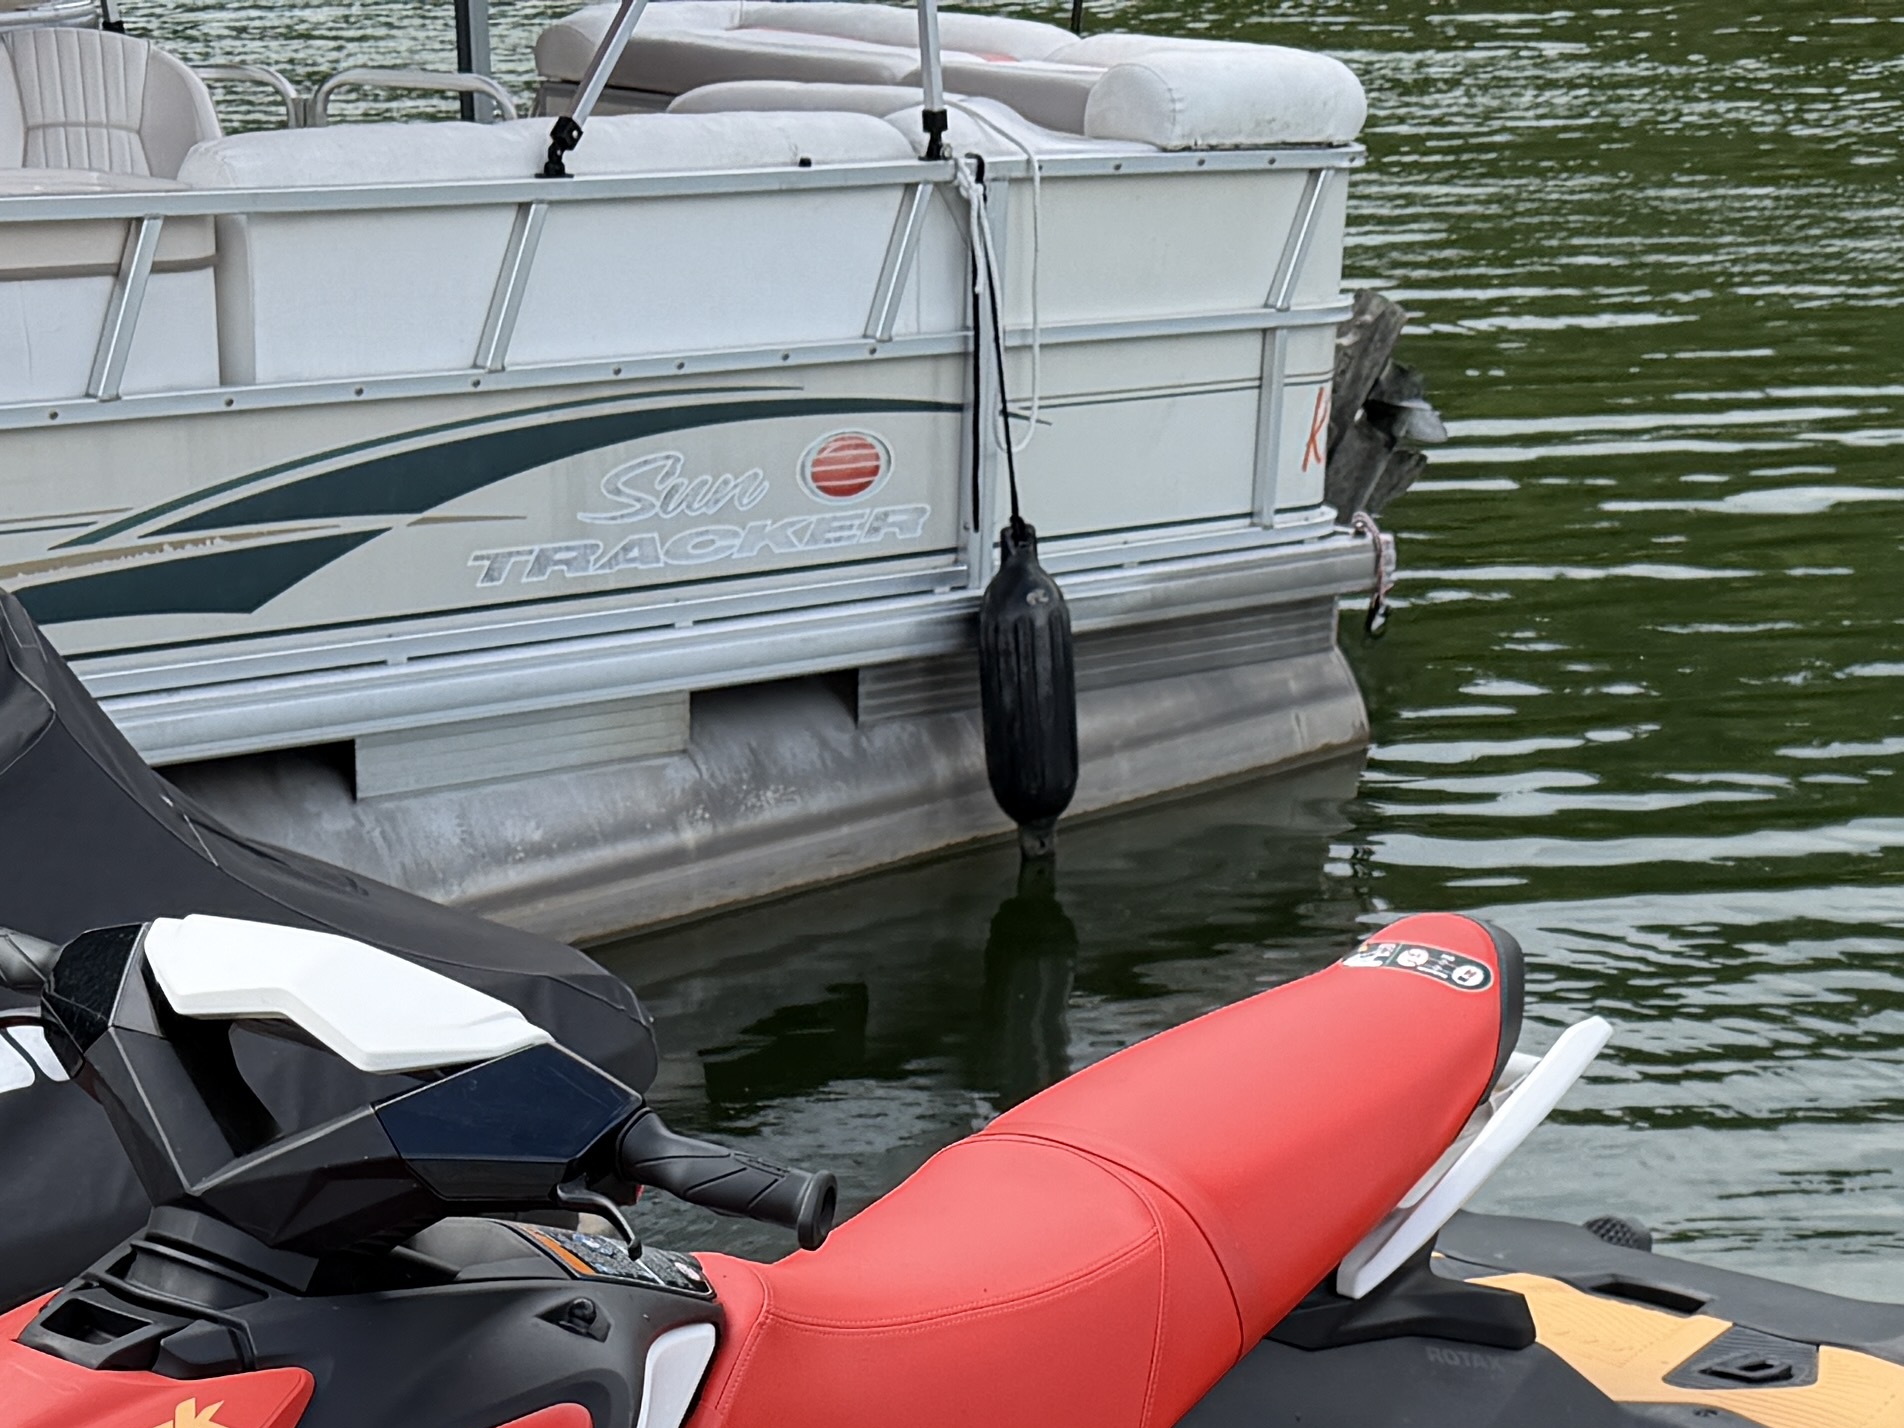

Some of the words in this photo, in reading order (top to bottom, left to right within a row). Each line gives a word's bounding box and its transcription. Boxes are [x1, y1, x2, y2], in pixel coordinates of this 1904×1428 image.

[577, 450, 771, 525] Sun
[467, 503, 931, 588] TRACKER
[1424, 1345, 1506, 1374] ROTAX
